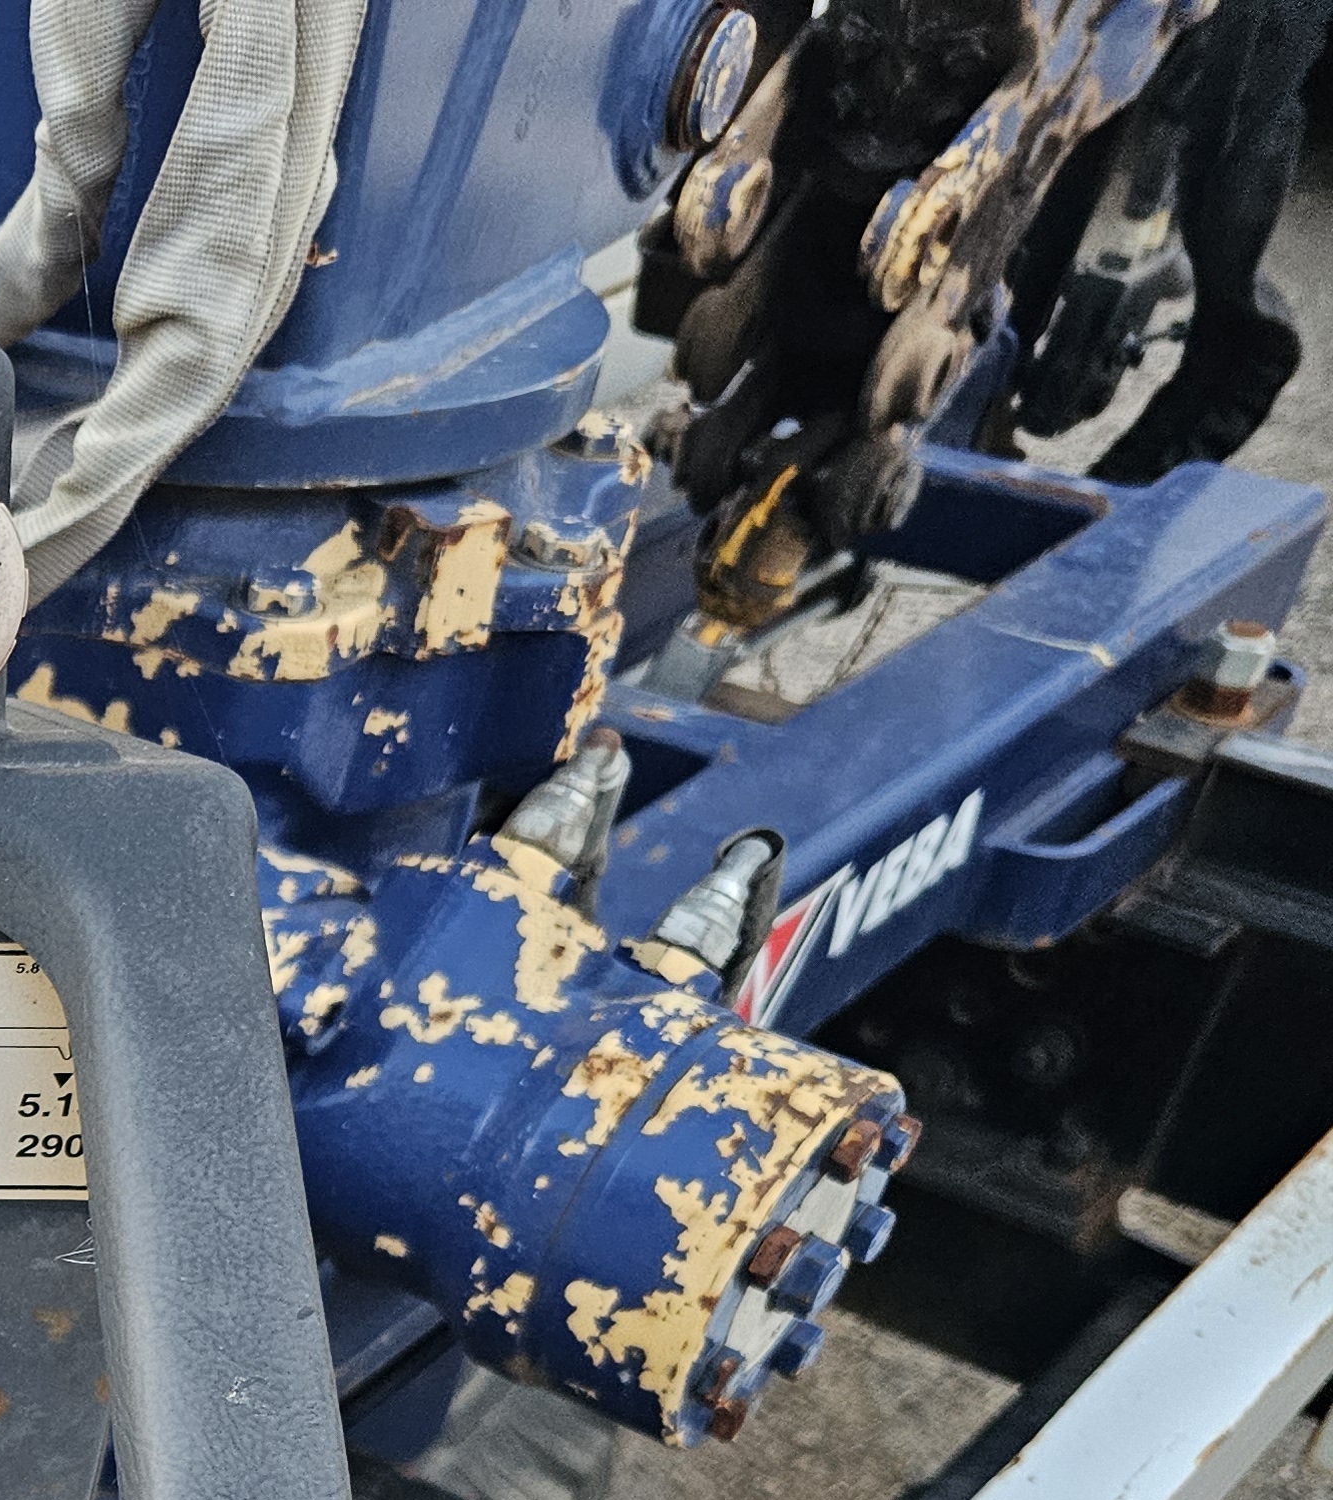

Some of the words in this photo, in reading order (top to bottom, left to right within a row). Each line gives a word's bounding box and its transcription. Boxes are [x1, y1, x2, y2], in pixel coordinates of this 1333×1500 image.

[827, 786, 986, 960] VEBA
[17, 1091, 75, 1118] 5.1
[15, 1134, 83, 1158] 290
